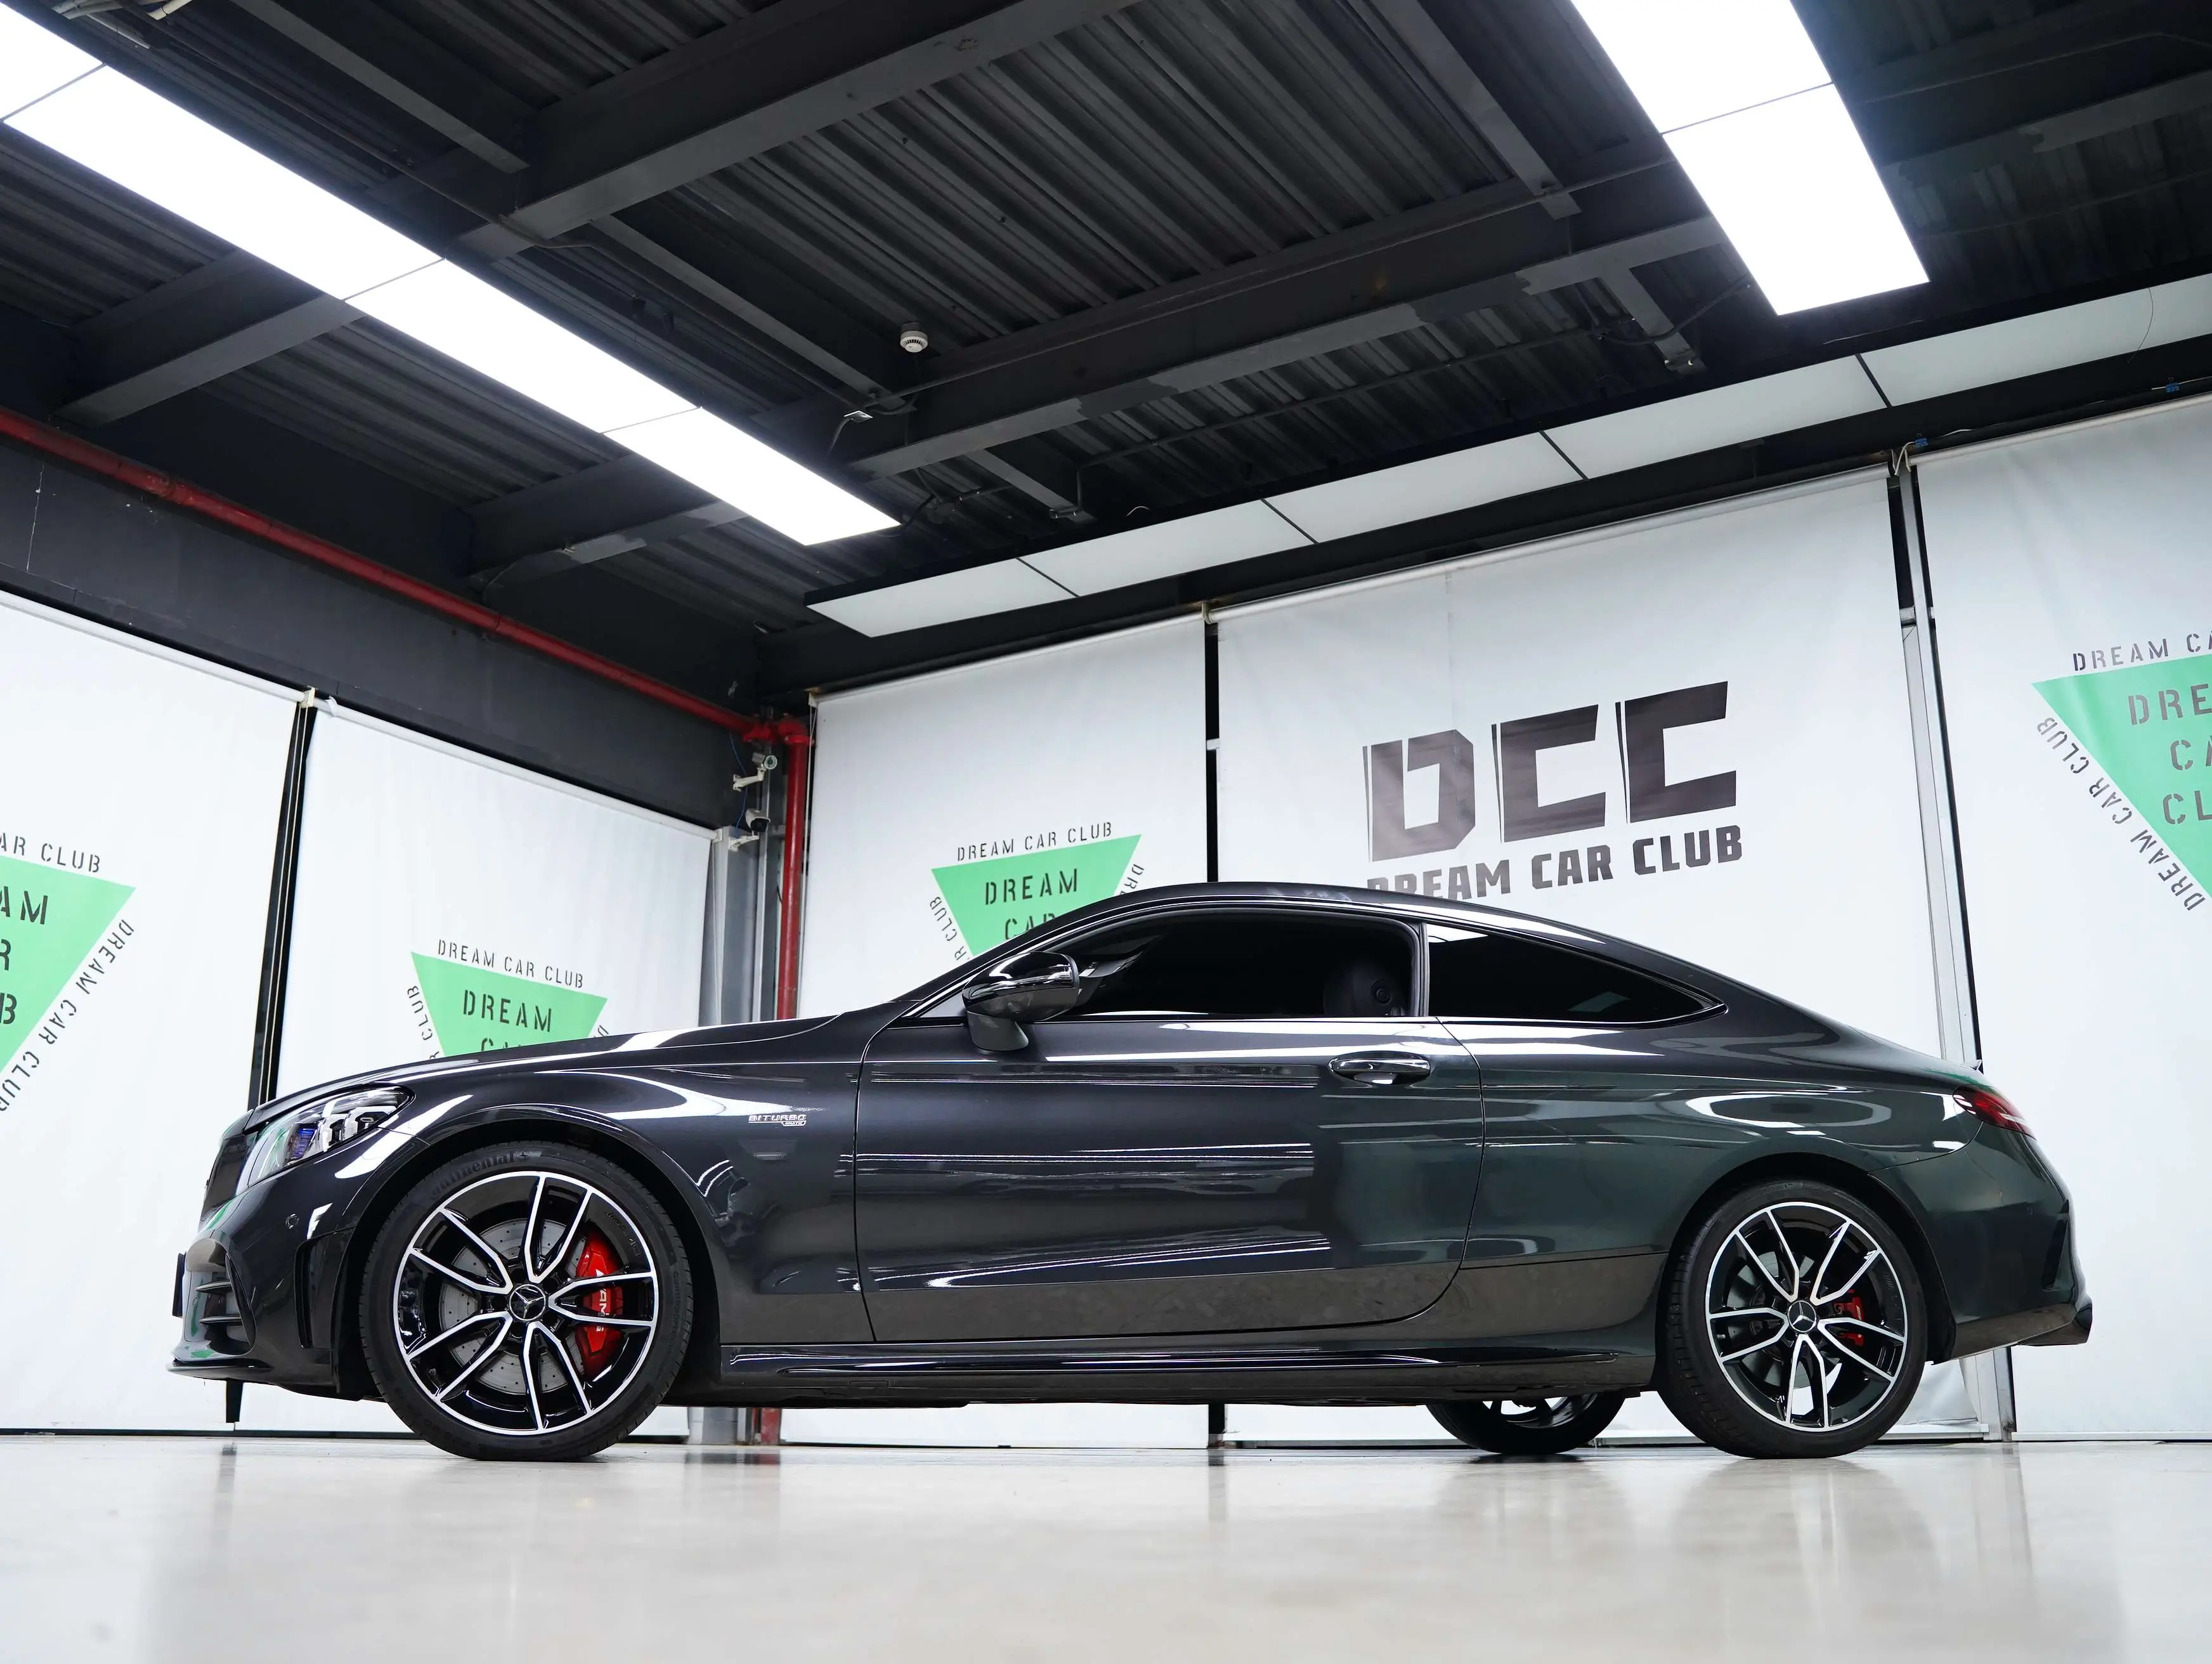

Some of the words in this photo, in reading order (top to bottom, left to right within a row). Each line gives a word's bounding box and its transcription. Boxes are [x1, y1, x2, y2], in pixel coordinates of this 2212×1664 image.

[2072, 638, 2169, 672] DREAM
[2037, 717, 2089, 774] CLUB
[1362, 680, 1736, 862] DCC
[2089, 777, 2132, 824] CAR
[41, 843, 100, 873] CLUB
[958, 838, 1013, 861] DREAM
[1025, 831, 1056, 850] CAR
[1068, 822, 1111, 843] CLUB
[1531, 844, 1614, 890] CAR
[1632, 824, 1742, 875] CLUB
[986, 868, 1077, 906] DREAM
[2130, 829, 2206, 911] DREAM
[930, 896, 958, 942] CLUB
[75, 920, 134, 995] DREAM
[438, 939, 495, 968] DREAM
[504, 956, 534, 977] CAR
[545, 966, 583, 989] CLUB
[38, 999, 77, 1044] CAR
[407, 985, 433, 1041] CLUB
[463, 989, 552, 1032] DREAM
